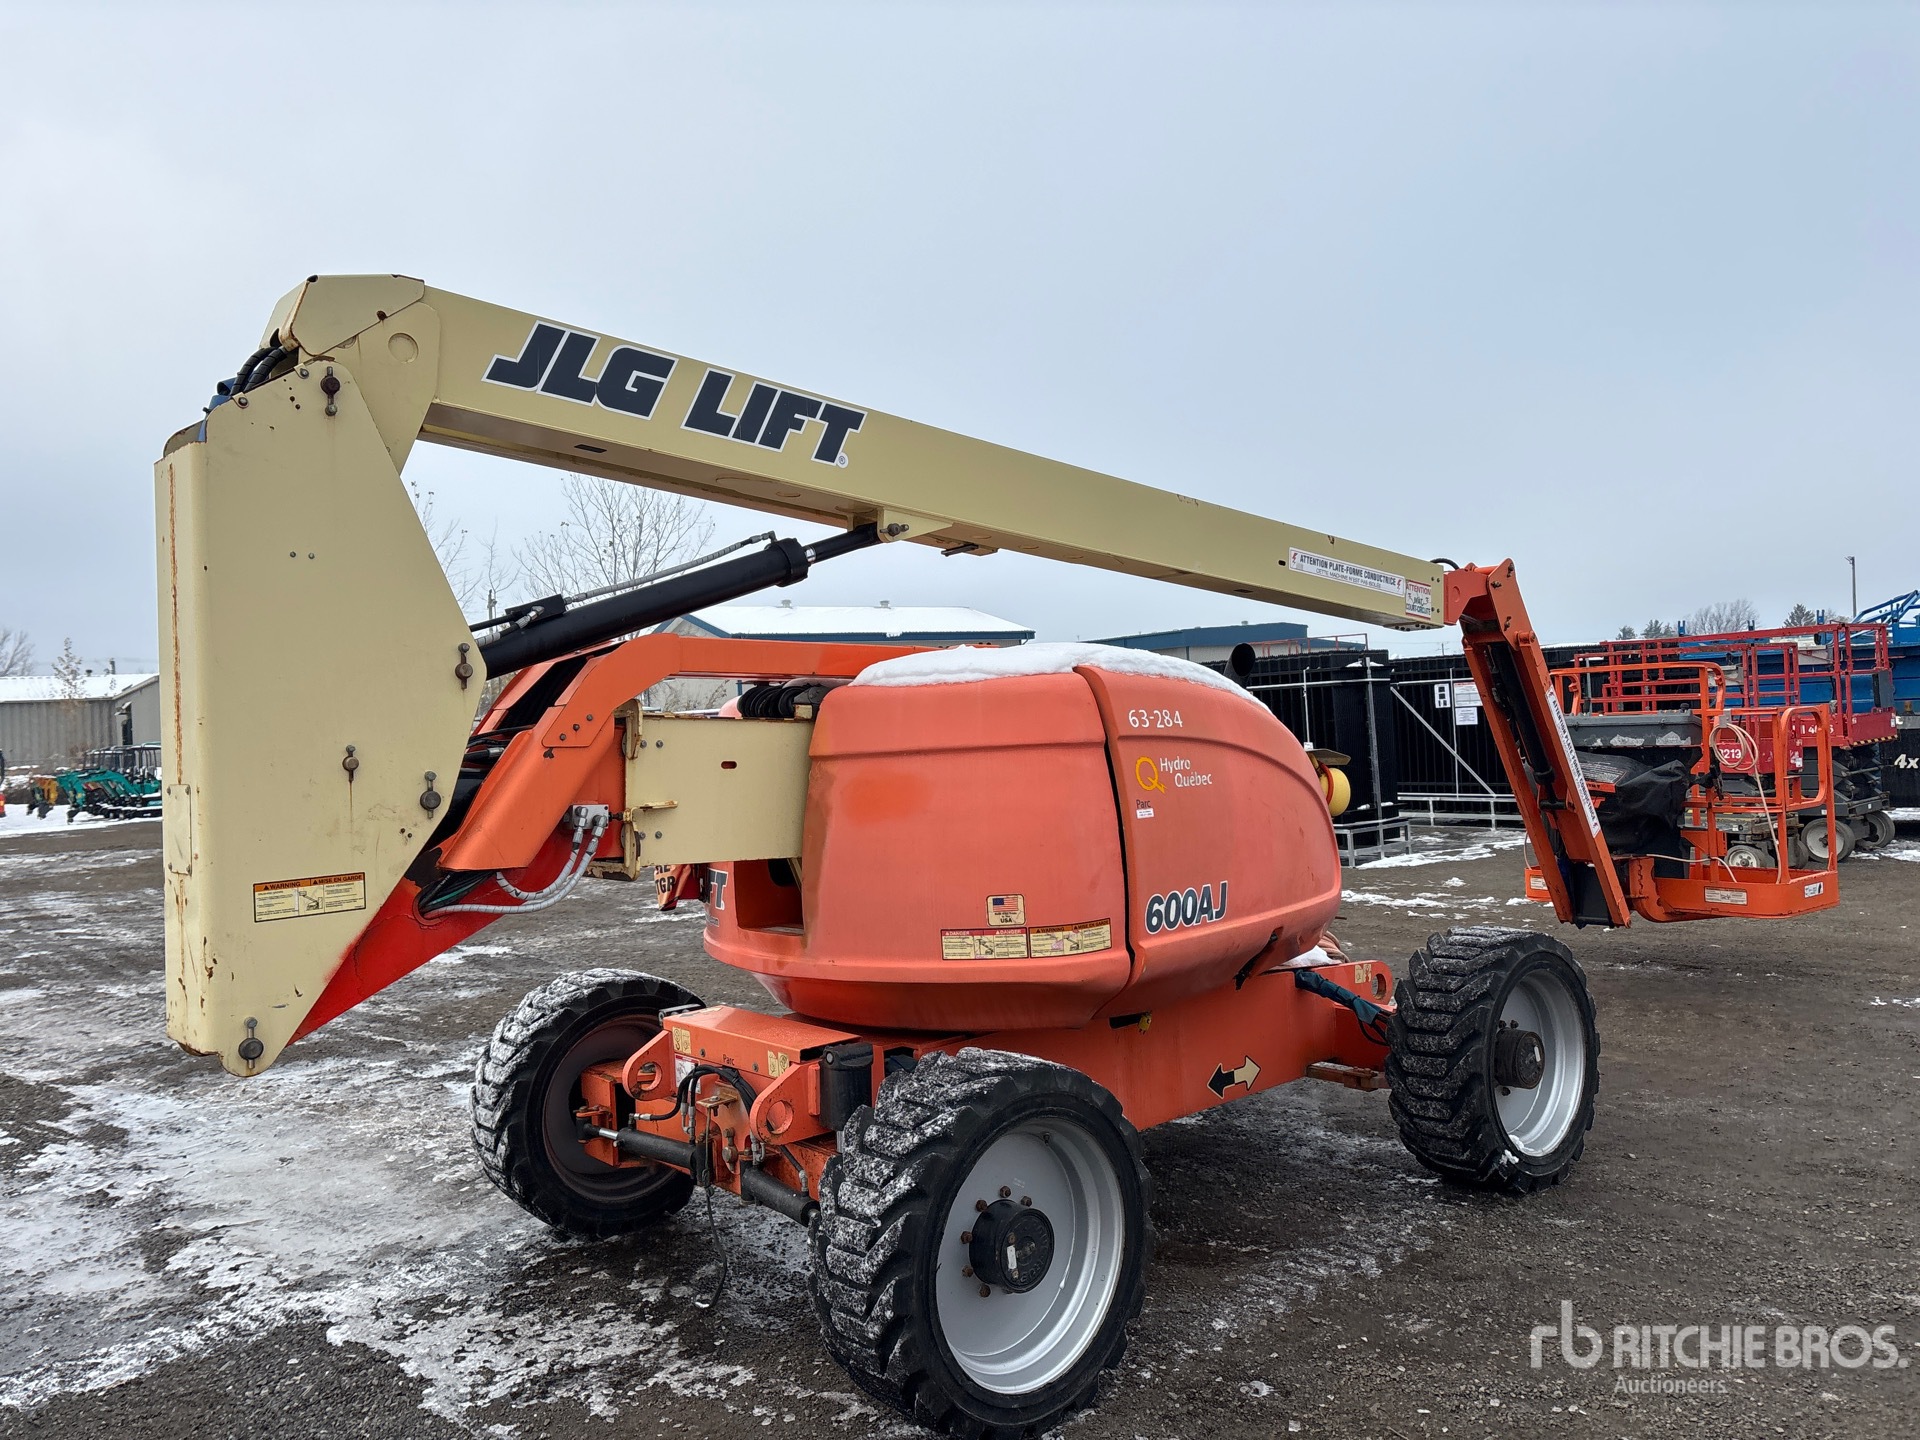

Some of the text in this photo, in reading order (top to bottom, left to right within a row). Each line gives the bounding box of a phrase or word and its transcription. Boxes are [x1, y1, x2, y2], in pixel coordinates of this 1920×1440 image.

[482, 320, 867, 466] JLG LIFT
[1300, 554, 1396, 586] ATTENTION PLATE-FORME CONDUCTRICE
[1406, 582, 1431, 595] ATTENTION
[1128, 709, 1183, 728] 63-284
[1160, 756, 1191, 773] Hydro
[1552, 700, 1566, 732] ATTENTION
[1579, 778, 1596, 820] CONDUCTRICE
[1174, 771, 1213, 788] Québec
[1136, 799, 1152, 809] Parc
[270, 881, 301, 891] WARNING
[318, 877, 332, 885] MISE
[343, 874, 363, 882] GARDE
[1145, 880, 1228, 935] 600AJ
[722, 1054, 735, 1066] Parc
